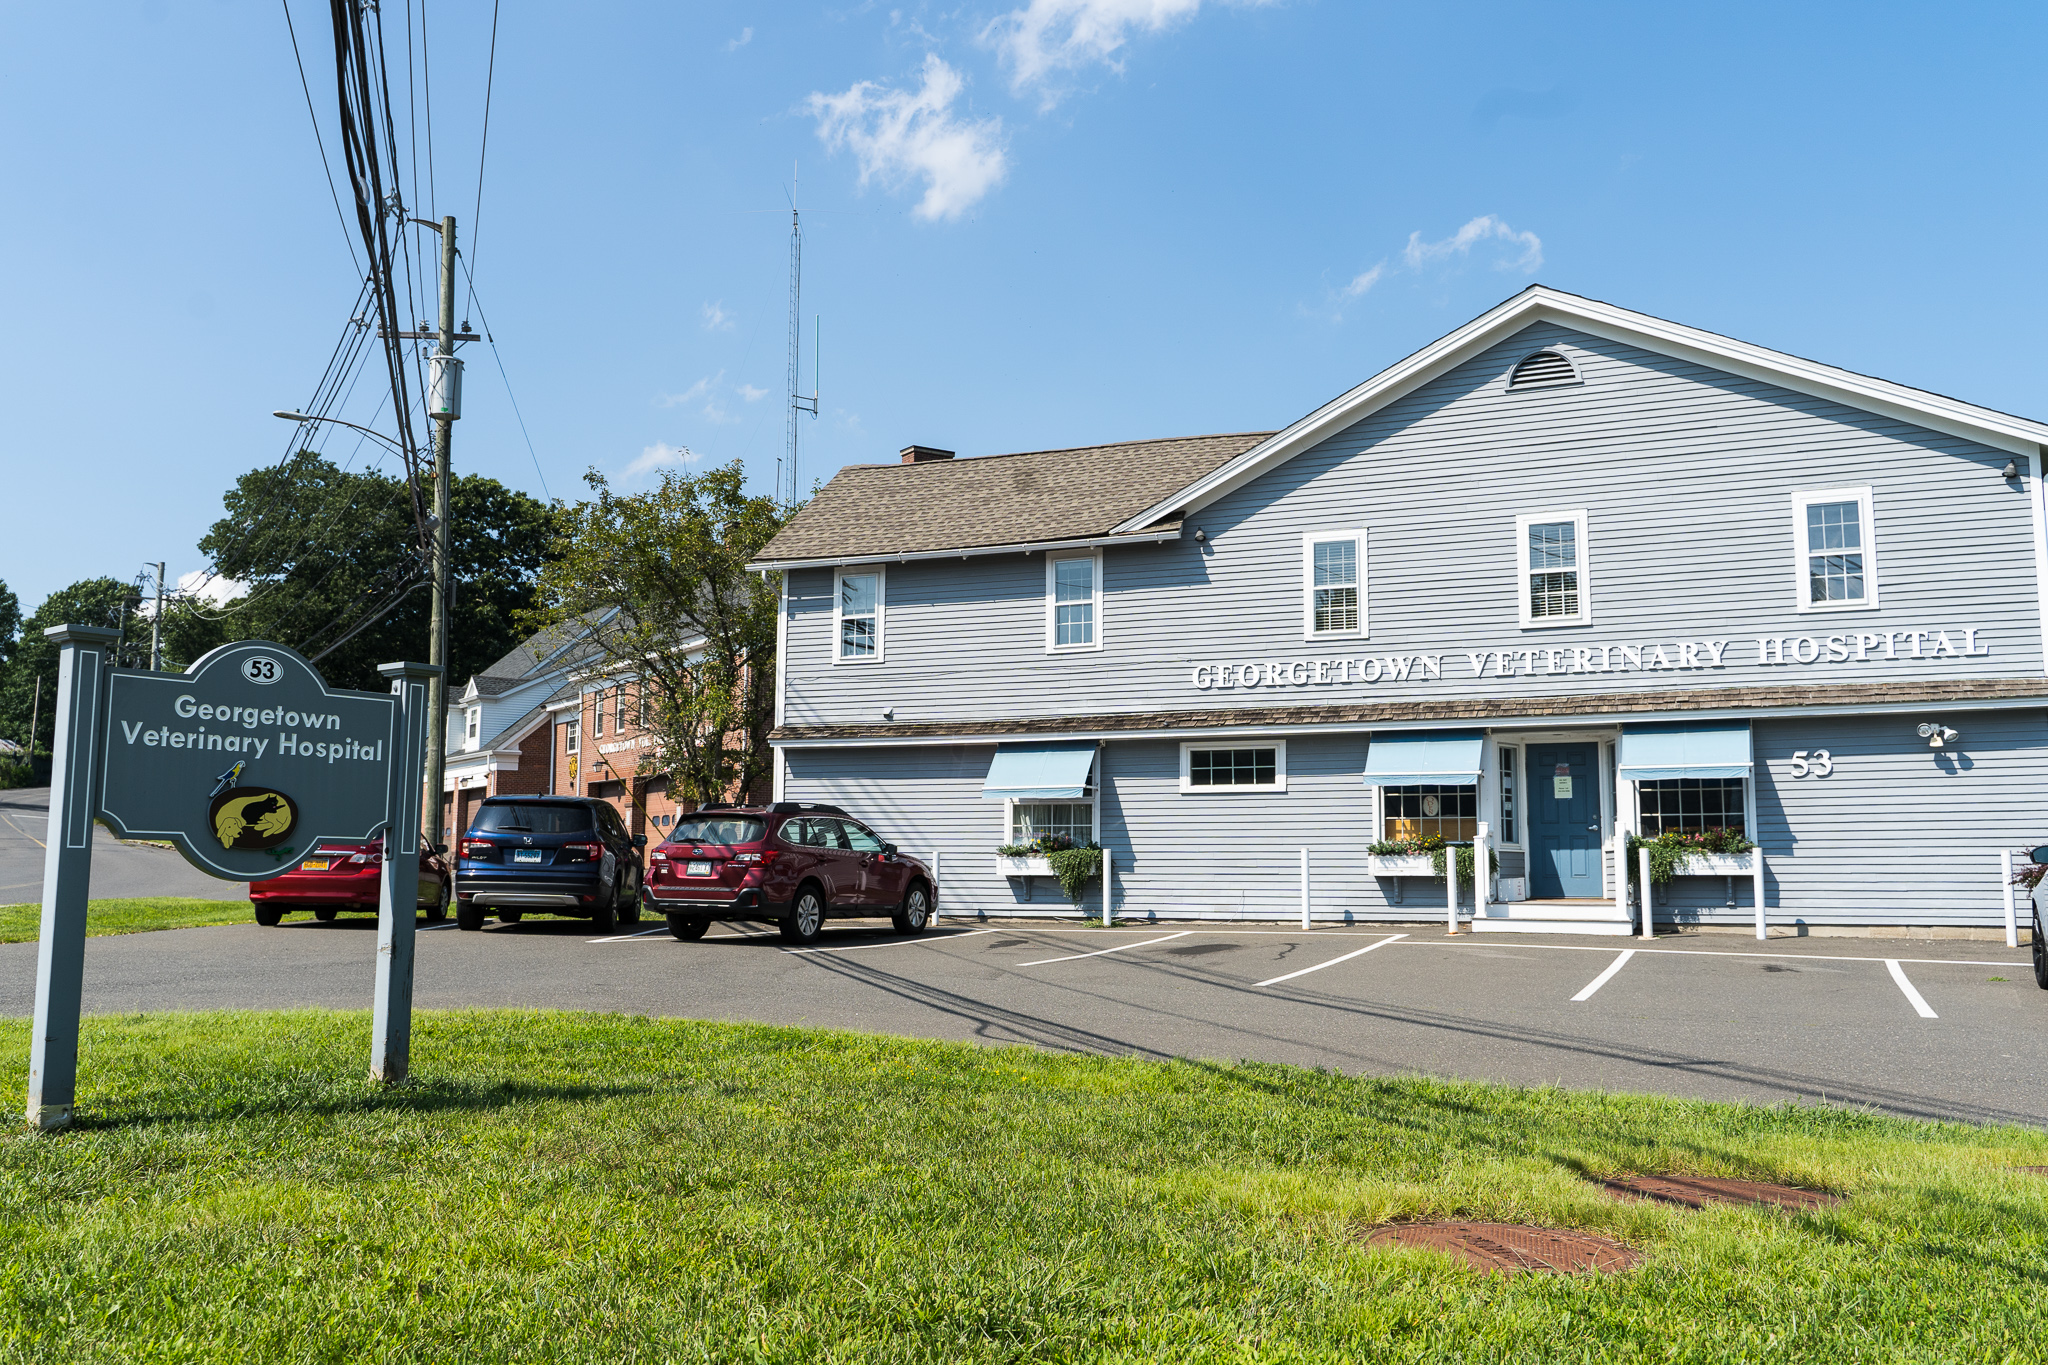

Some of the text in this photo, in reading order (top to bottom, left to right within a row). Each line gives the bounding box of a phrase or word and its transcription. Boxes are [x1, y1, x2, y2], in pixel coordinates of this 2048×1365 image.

[249, 660, 275, 679] 53
[1192, 628, 1989, 690] GEORGETOWN VETERINARY HOSPITAL
[174, 694, 341, 730] Georgetown
[121, 720, 382, 763] Veterinary Hospital
[1791, 749, 1832, 778] 53
